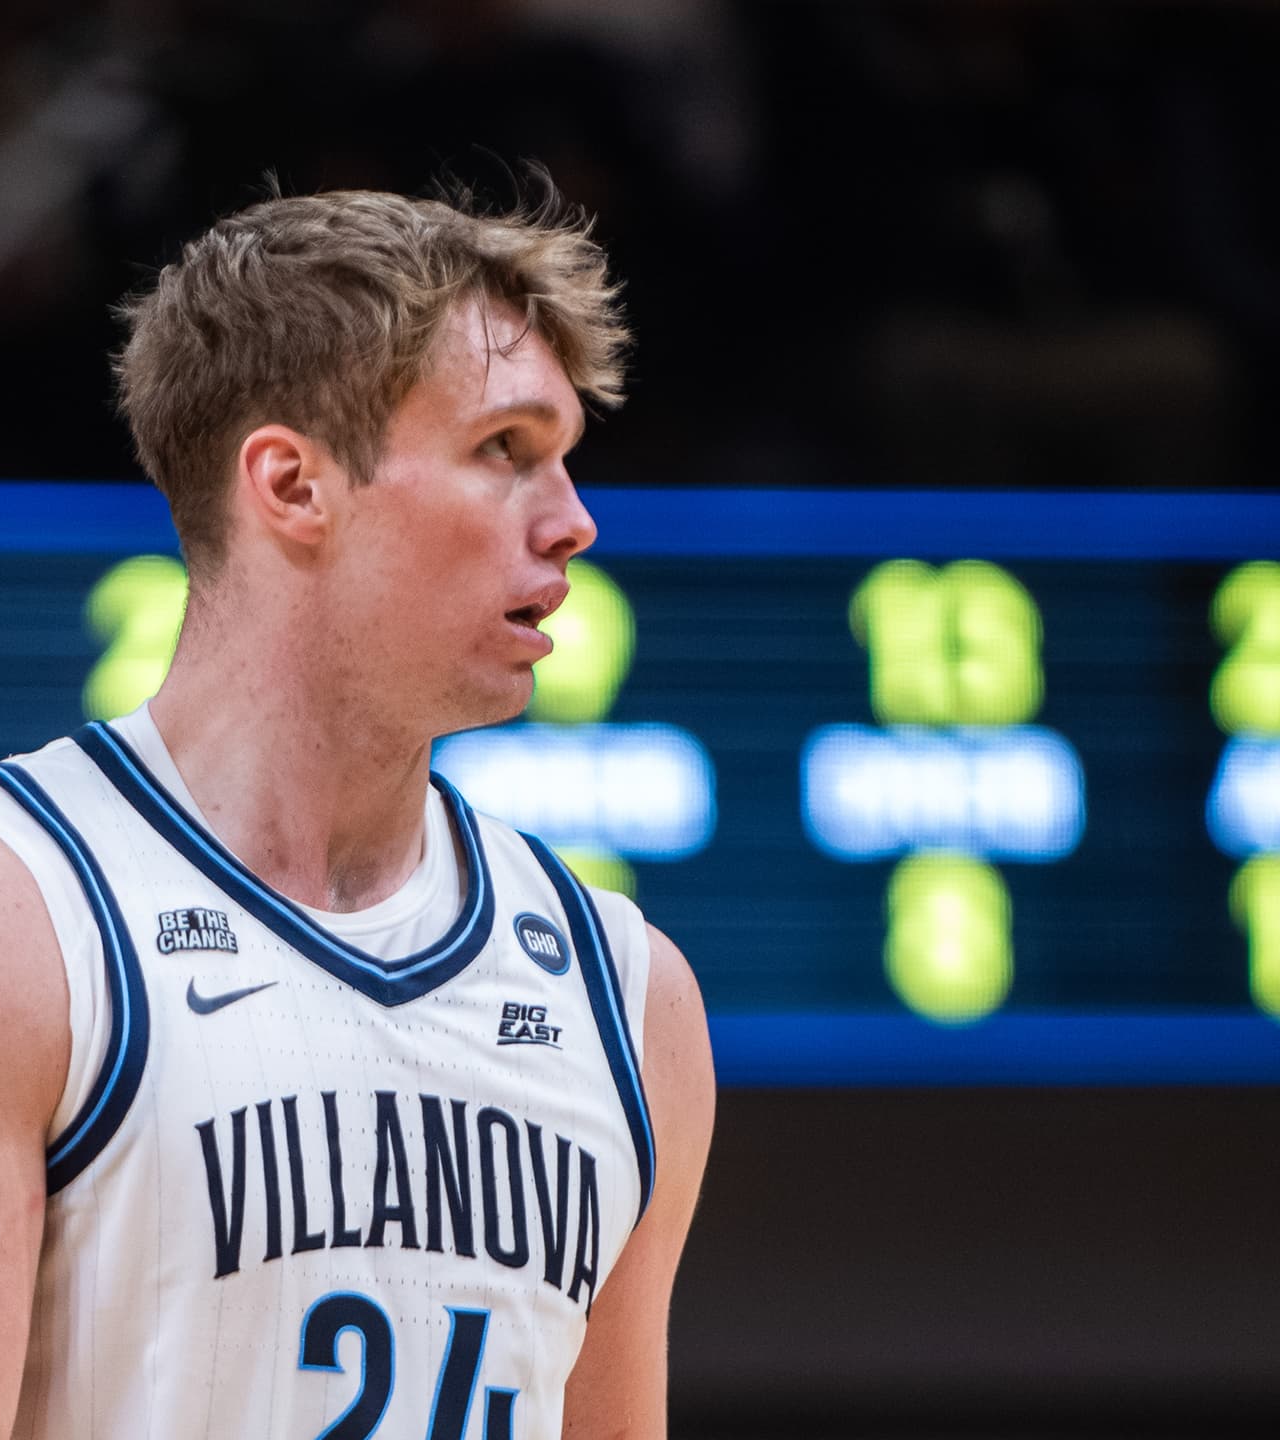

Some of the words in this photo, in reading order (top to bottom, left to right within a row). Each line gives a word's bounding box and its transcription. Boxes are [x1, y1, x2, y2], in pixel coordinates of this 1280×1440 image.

[159, 909, 190, 931] BE
[194, 908, 230, 931] THE
[158, 928, 238, 953] CHANGE
[522, 928, 561, 958] GHR
[502, 1001, 547, 1023] BIG
[498, 1020, 563, 1042] EAST
[194, 1090, 601, 1322] VILLANOVA
